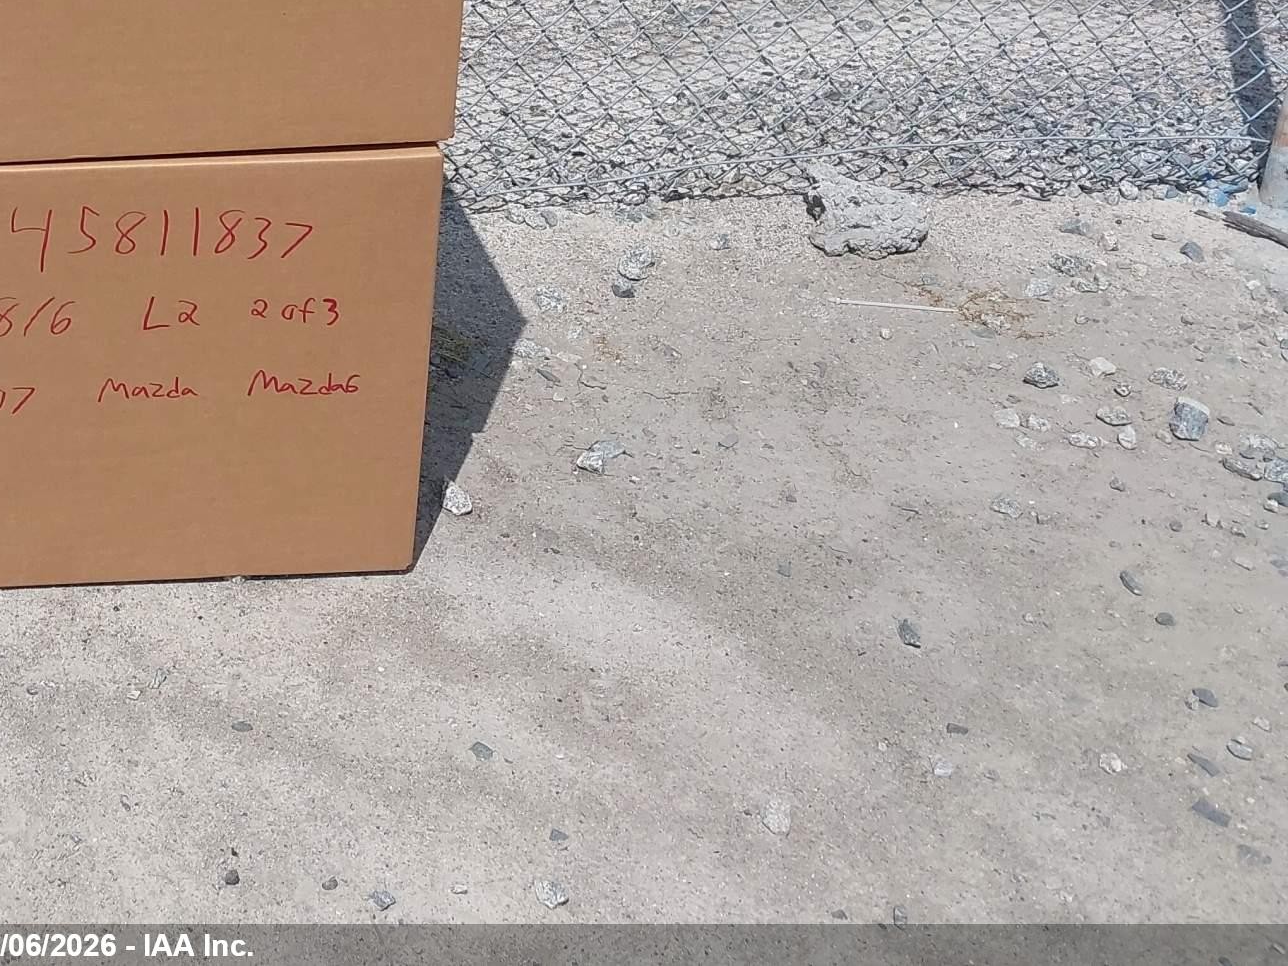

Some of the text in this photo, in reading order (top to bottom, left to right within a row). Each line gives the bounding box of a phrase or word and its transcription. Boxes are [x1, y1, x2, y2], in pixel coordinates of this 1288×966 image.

[11, 206, 314, 273] 45811837
[97, 376, 198, 403] Mazda
[247, 369, 361, 396] Mazda6
